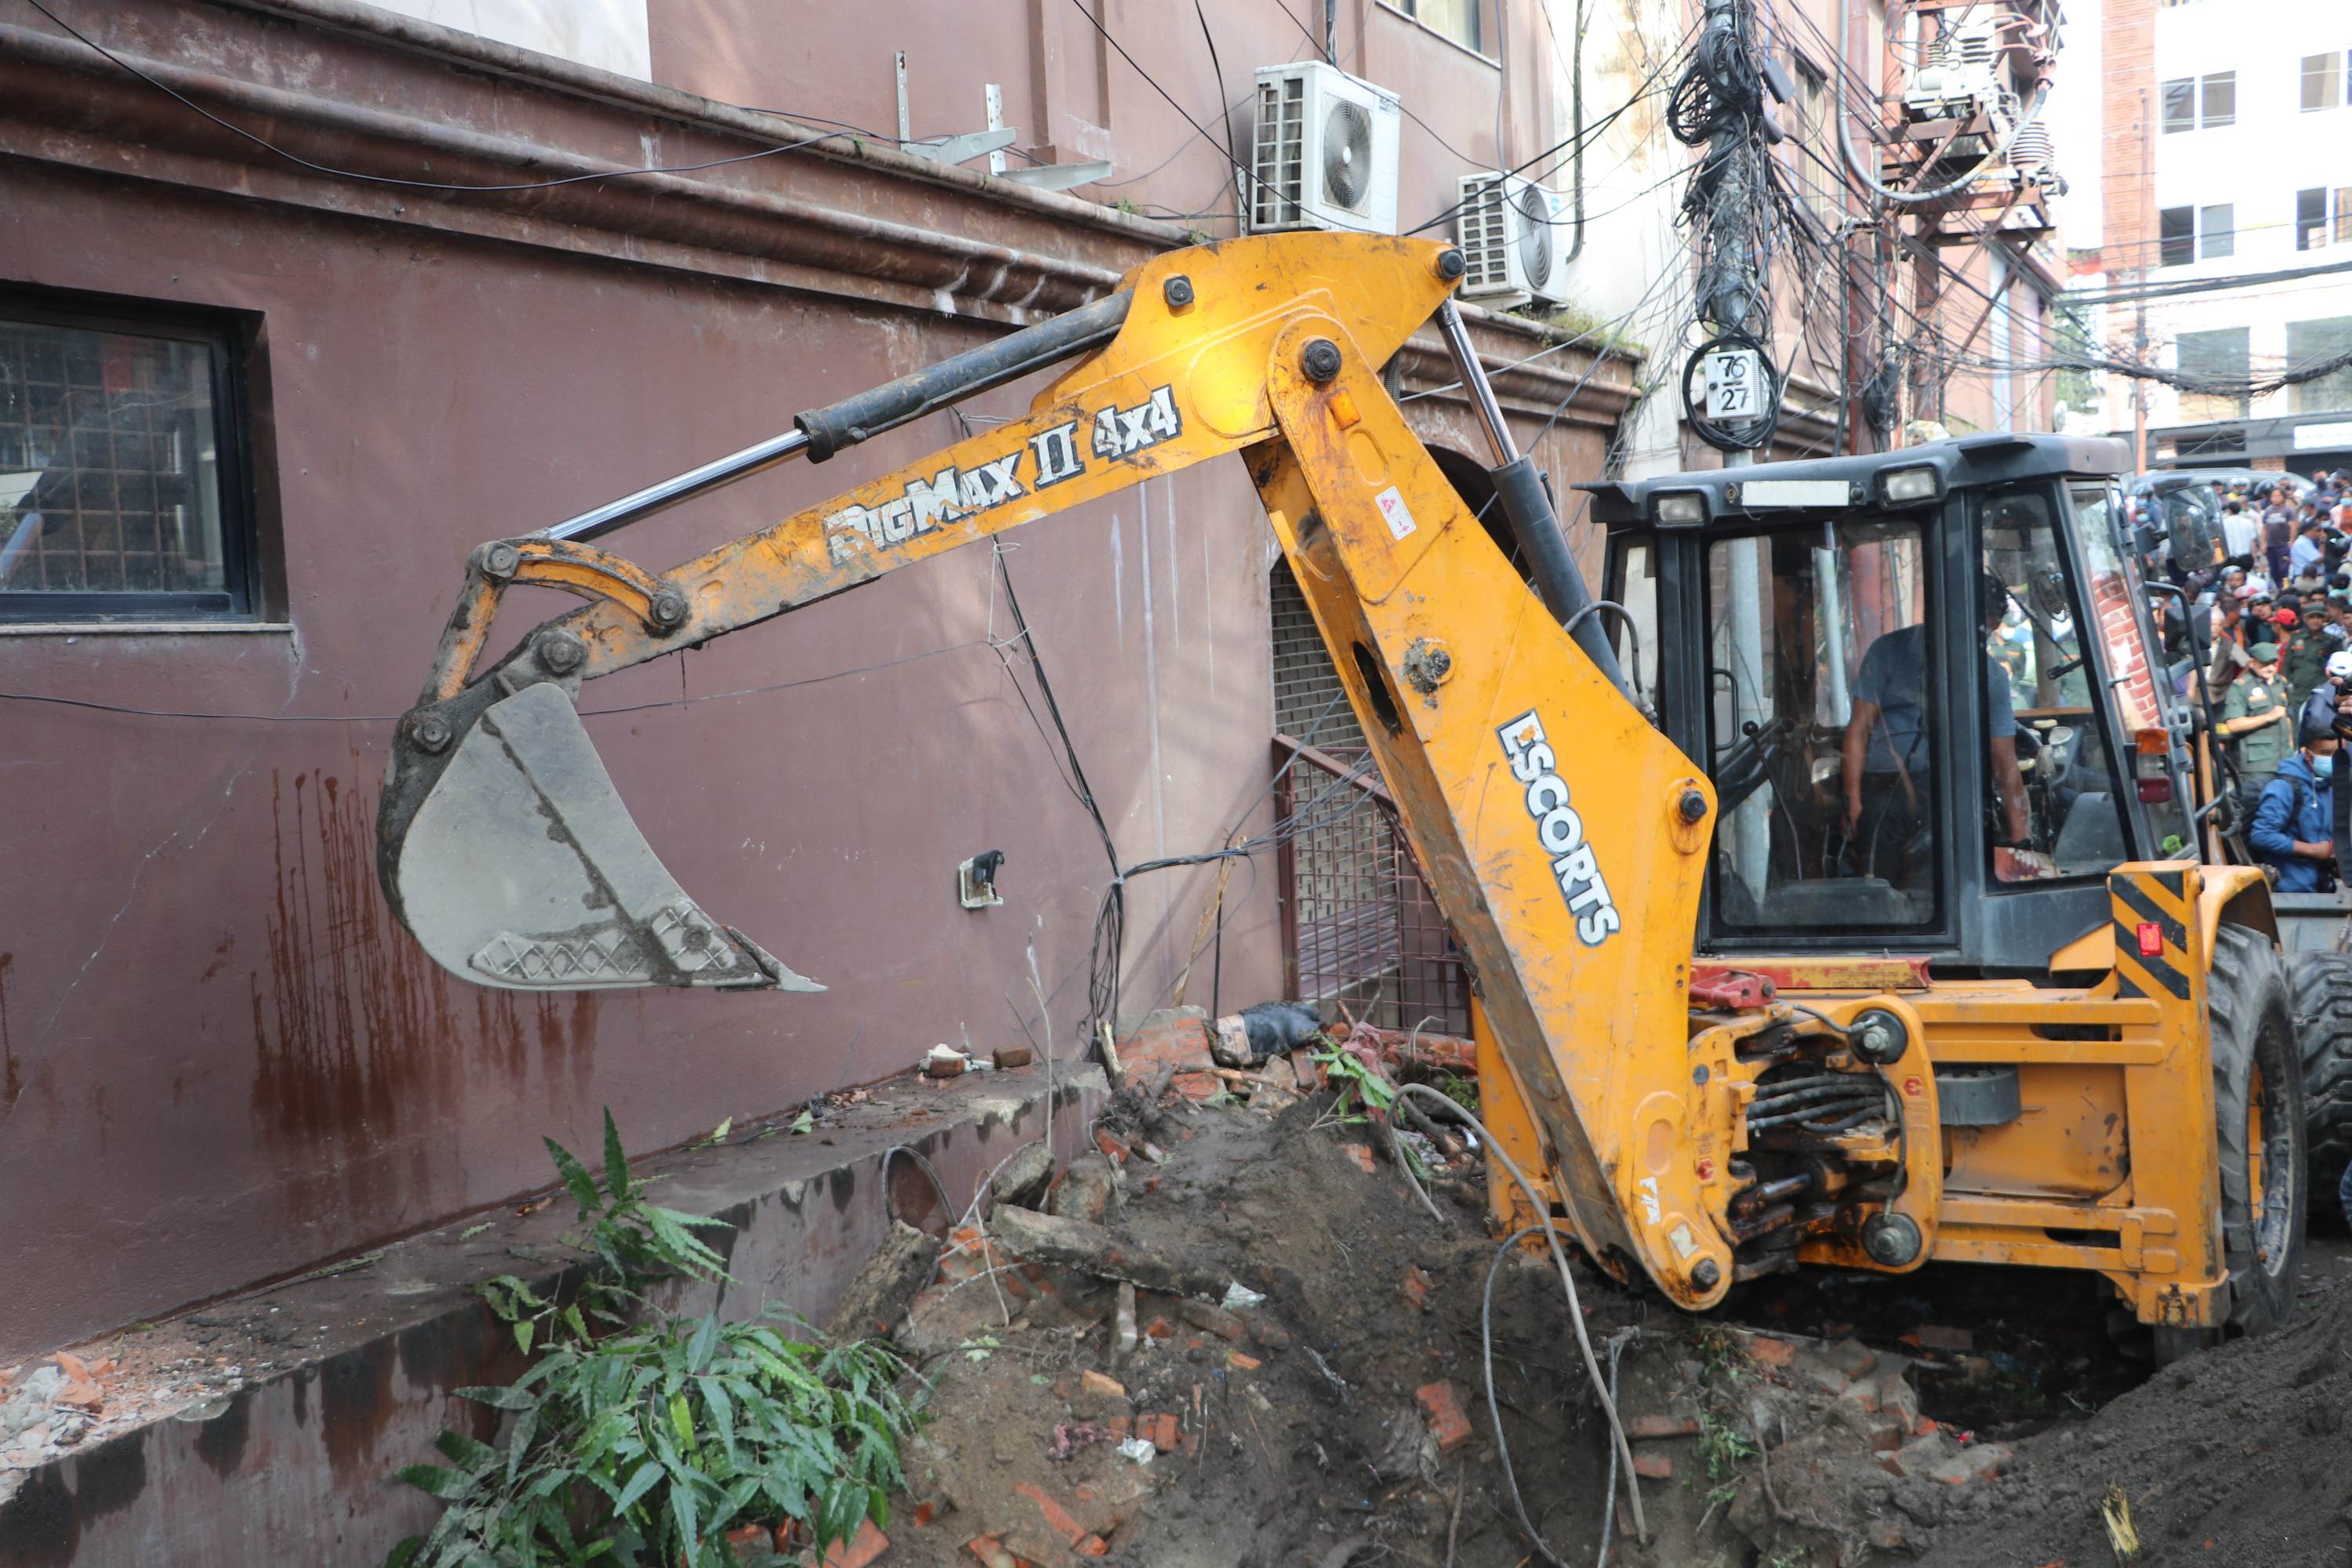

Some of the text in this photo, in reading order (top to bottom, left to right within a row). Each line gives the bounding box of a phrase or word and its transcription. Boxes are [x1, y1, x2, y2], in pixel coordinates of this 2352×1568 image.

[1717, 356, 1751, 379] 76
[1720, 387, 1750, 412] 27
[1494, 708, 1621, 947] ESCORTS
